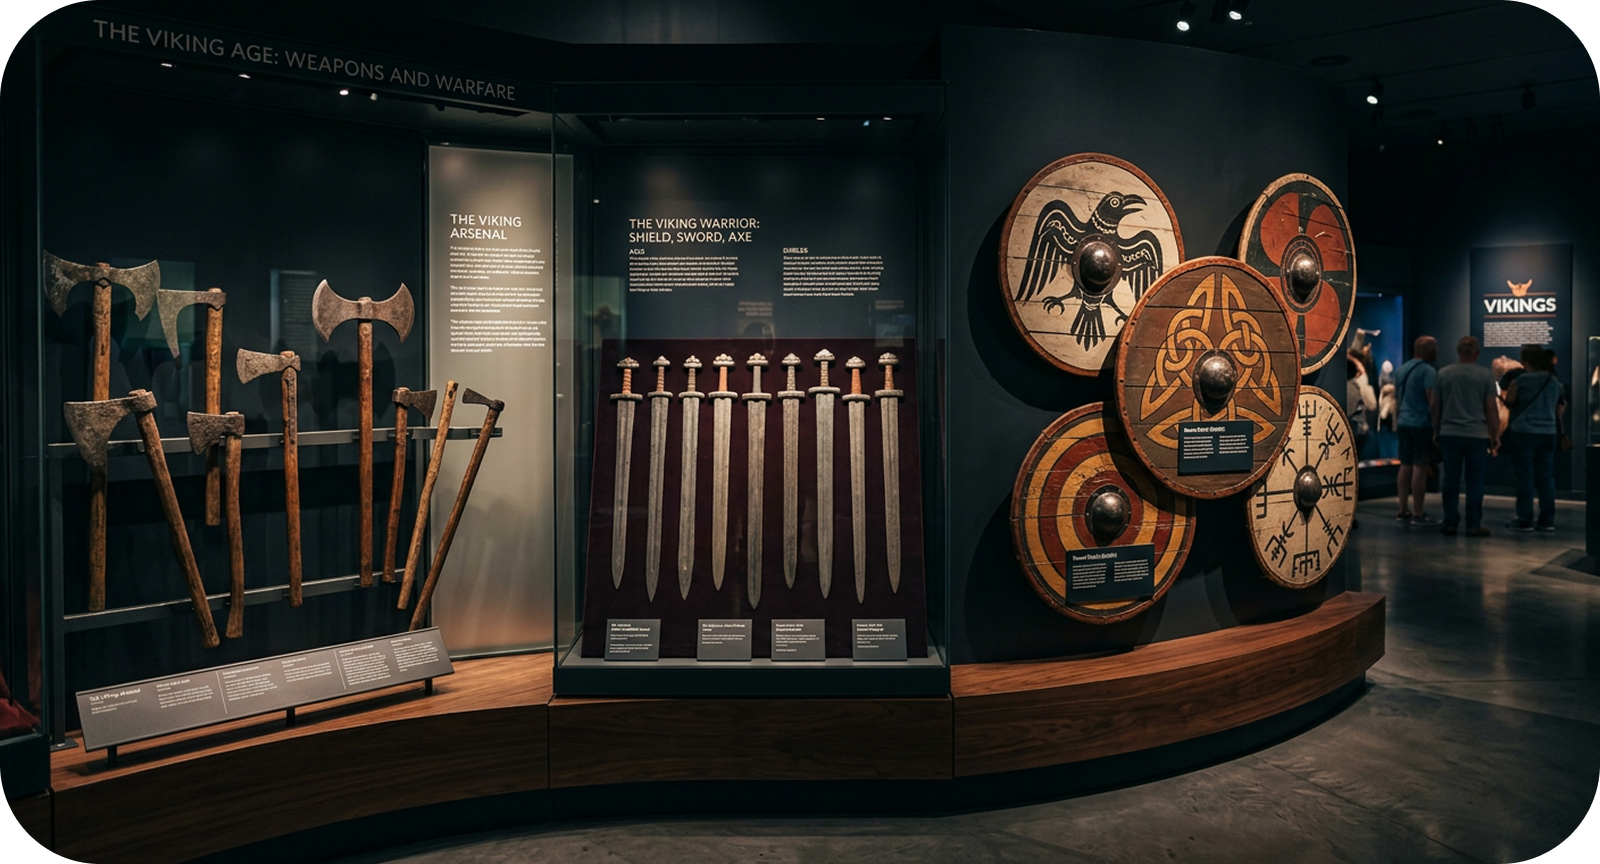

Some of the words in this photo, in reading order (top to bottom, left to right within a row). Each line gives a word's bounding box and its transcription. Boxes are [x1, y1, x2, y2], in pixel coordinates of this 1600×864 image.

[93, 19, 140, 44] THE
[146, 27, 224, 56] VIKING
[231, 42, 279, 65] AGE:
[285, 50, 385, 81] WEAPONS
[389, 67, 430, 87] AND
[434, 74, 516, 101] WARFARE
[450, 213, 476, 225] THE
[478, 215, 522, 228] VIKING
[629, 218, 653, 229] THE
[655, 218, 697, 229] VIKING
[699, 217, 760, 229] WARRIOR:
[450, 228, 508, 240] ARSENAL
[629, 231, 674, 244] SHIELD,
[676, 231, 725, 244] SWORD,
[728, 231, 752, 242] AXE
[1483, 297, 1557, 313] VIKINGS
